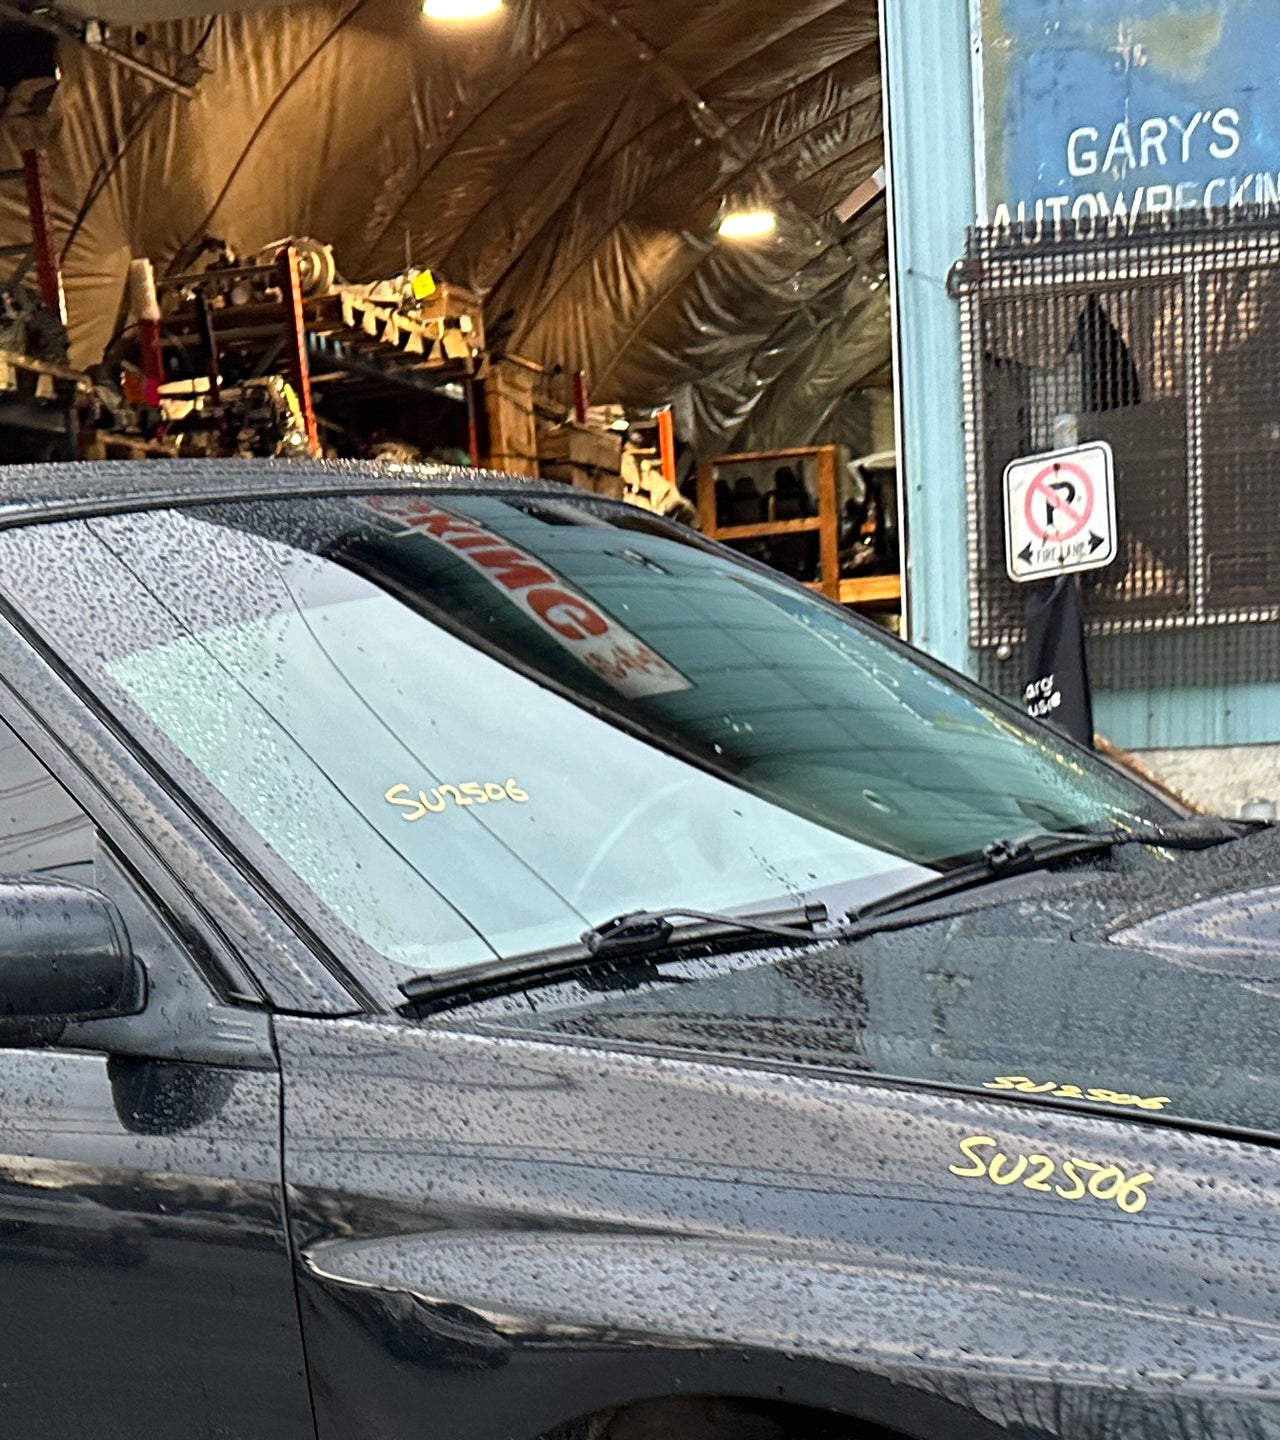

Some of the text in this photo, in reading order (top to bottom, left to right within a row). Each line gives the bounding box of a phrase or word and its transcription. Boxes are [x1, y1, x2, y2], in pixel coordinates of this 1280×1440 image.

[1067, 107, 1240, 177] GARY'S
[384, 778, 530, 821] SU2506
[948, 1135, 1155, 1214] SU2506
